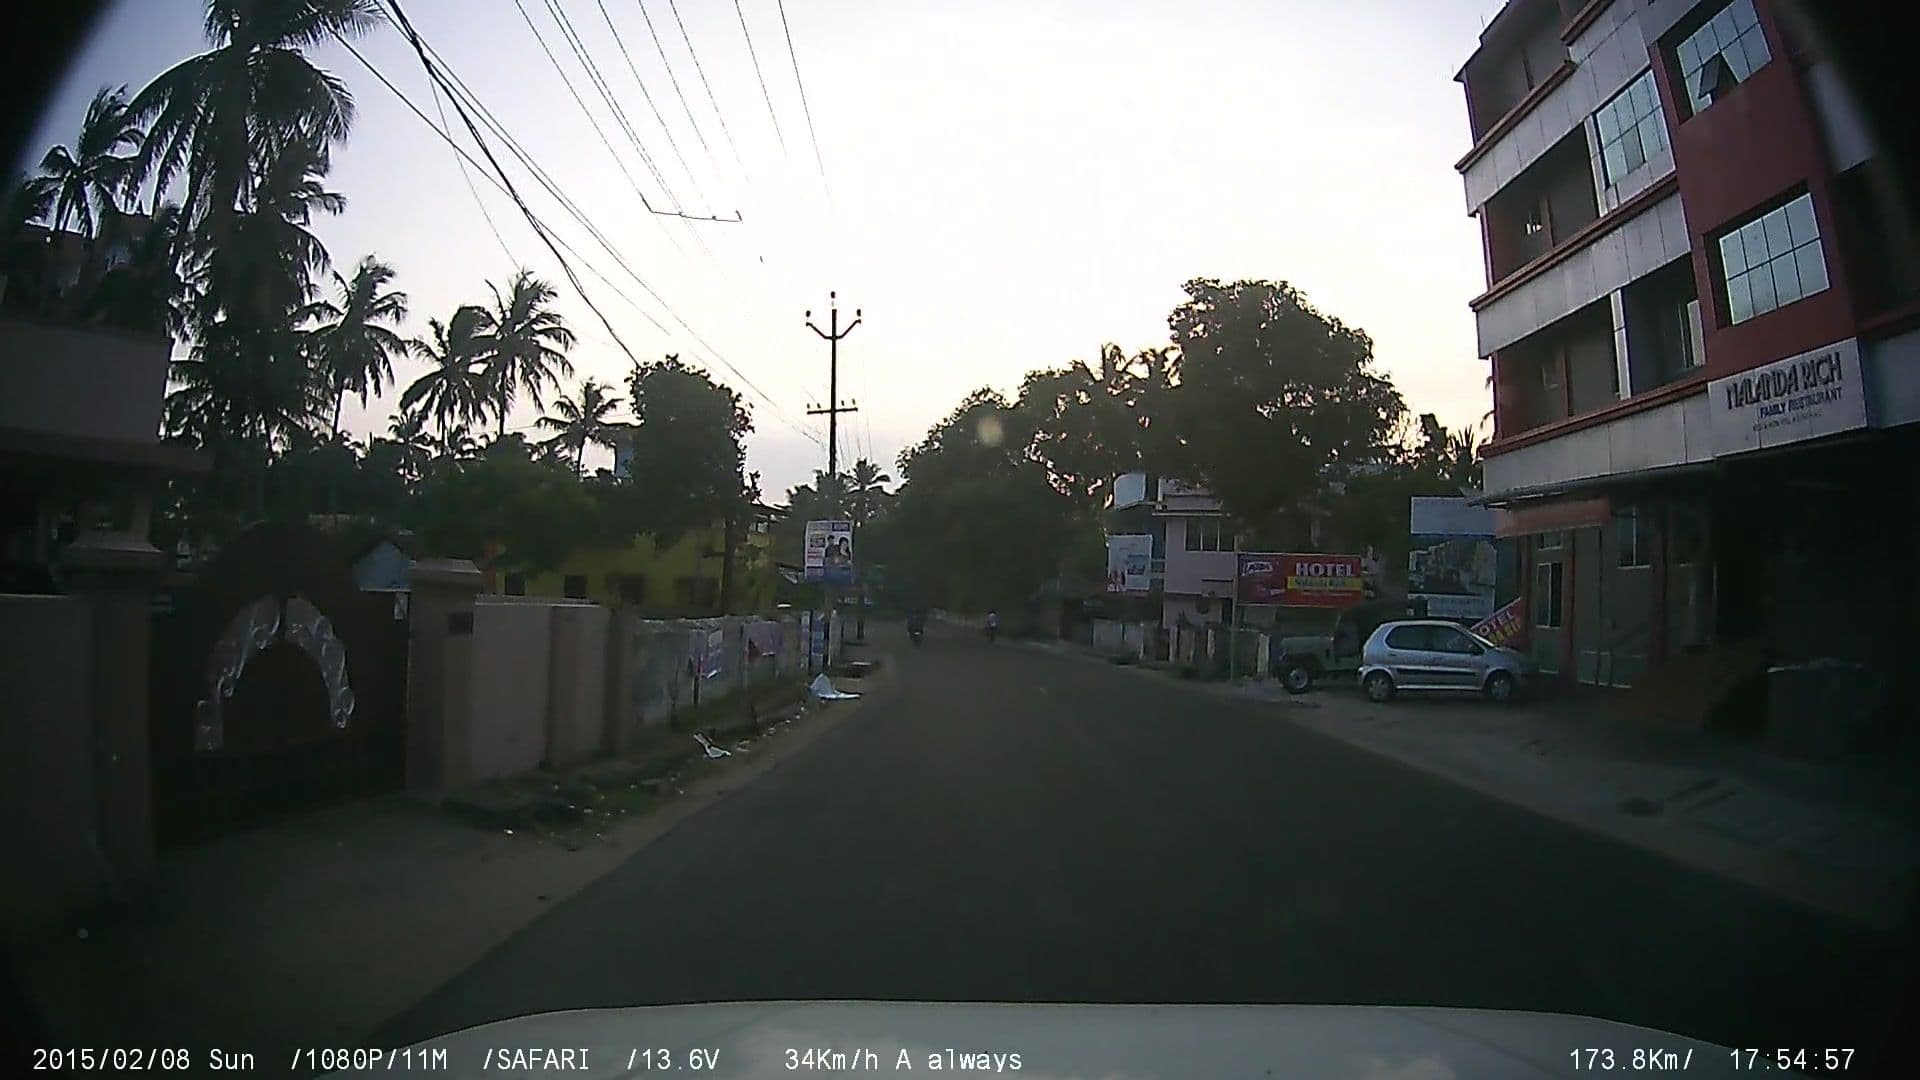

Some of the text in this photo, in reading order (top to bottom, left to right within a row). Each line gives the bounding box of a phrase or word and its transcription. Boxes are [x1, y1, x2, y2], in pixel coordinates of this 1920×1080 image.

[1726, 352, 1843, 410] NALANDA RICH
[1759, 386, 1843, 419] FAMILY RESTAURANT
[1295, 561, 1355, 577] HOTEL
[1479, 608, 1515, 637] OTEL
